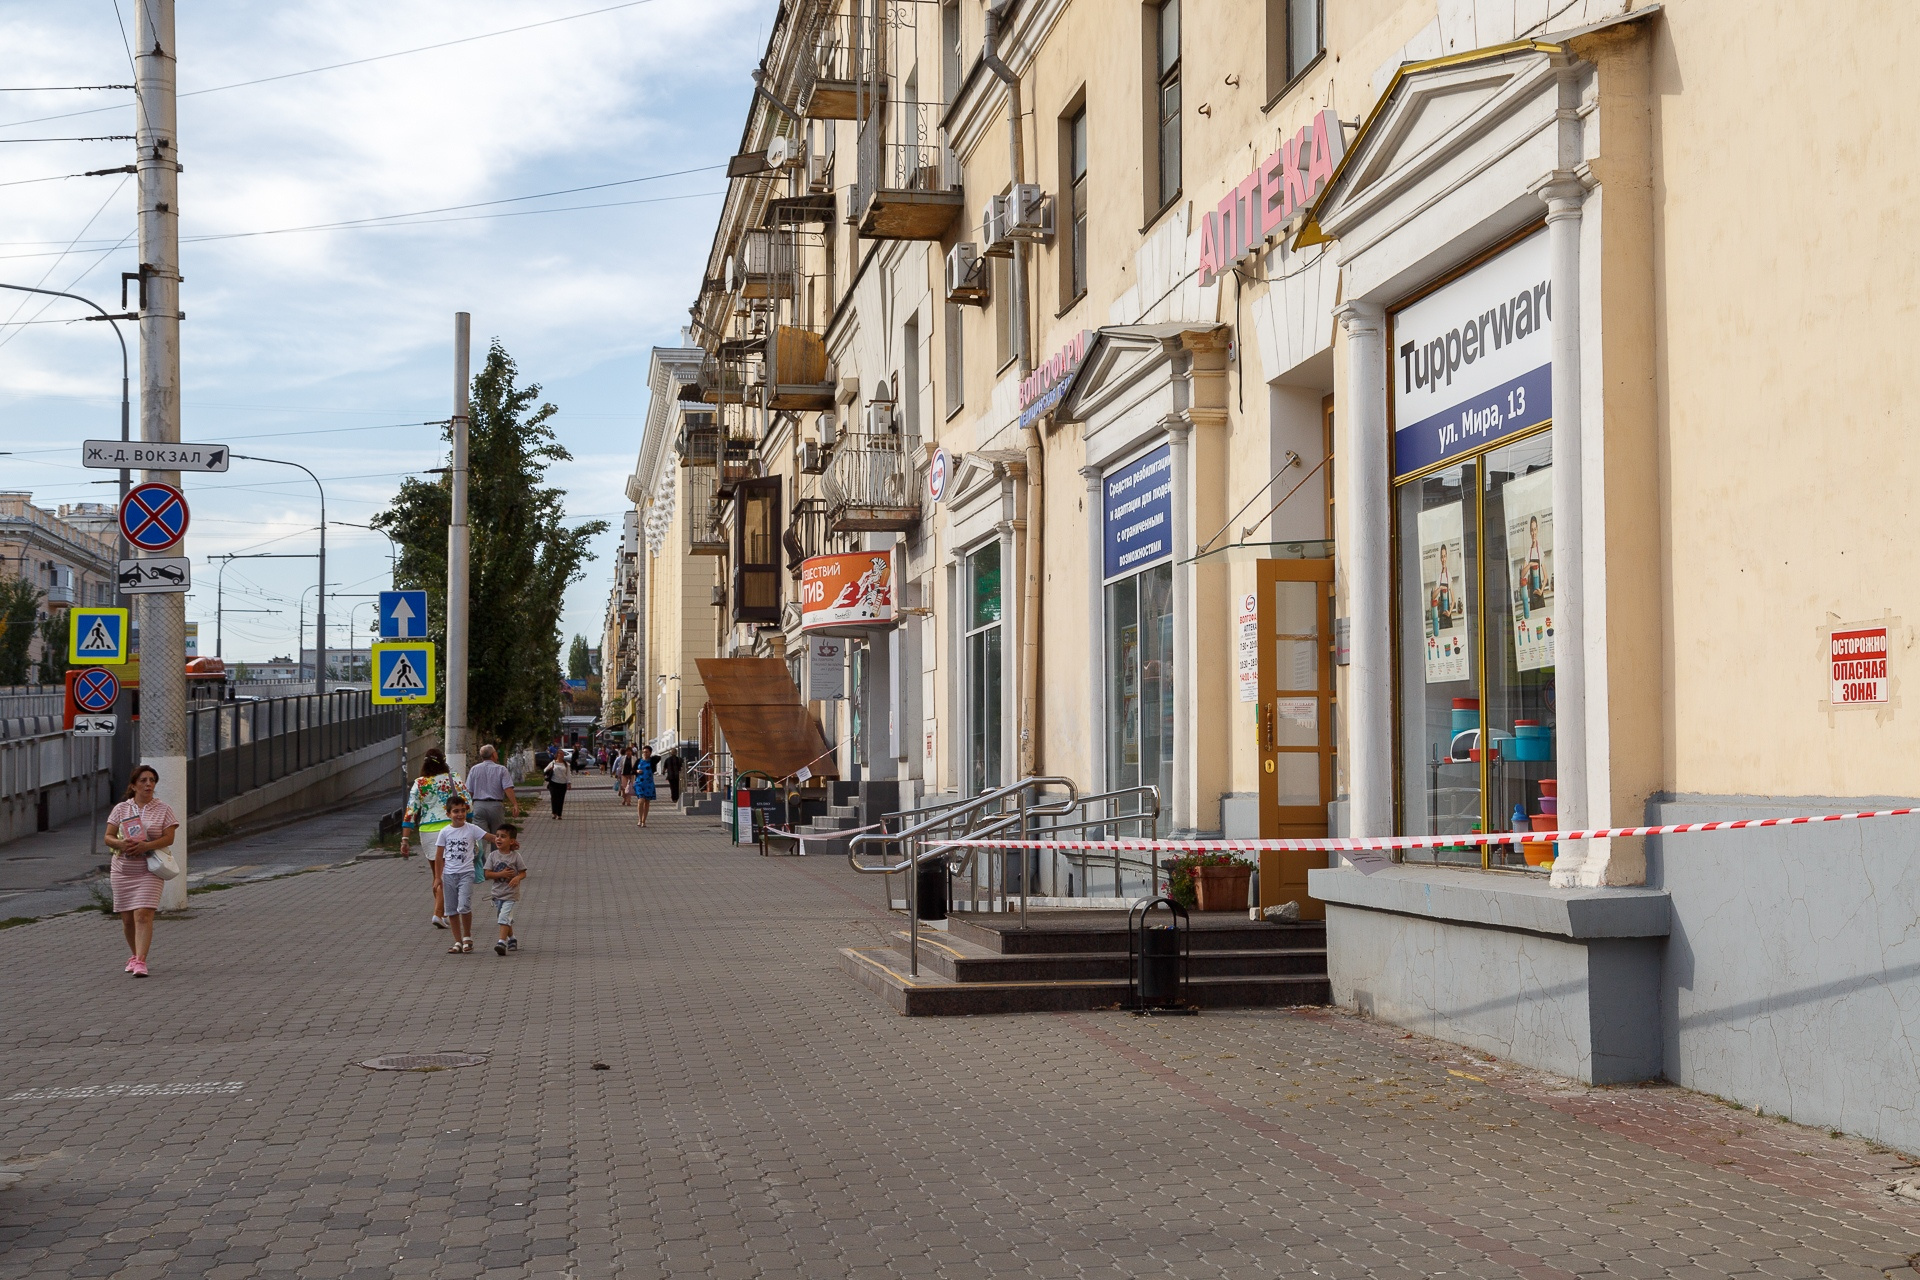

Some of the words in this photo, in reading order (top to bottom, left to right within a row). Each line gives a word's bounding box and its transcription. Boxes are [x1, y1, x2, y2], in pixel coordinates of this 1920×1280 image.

[1198, 109, 1336, 287] АПТЕКА
[1018, 329, 1086, 411] ВОЛГОФАРМ
[1438, 424, 1459, 454] ул.
[1461, 403, 1504, 438] Мира,
[1507, 385, 1526, 420] 13
[87, 448, 129, 463] Ж.-Д.
[134, 449, 201, 463] ВОКЗАЛ
[1109, 474, 1133, 499] Средства
[1109, 509, 1114, 522] и
[1114, 497, 1141, 521] адаптации
[1141, 489, 1152, 509] для
[1116, 531, 1121, 543] с
[1121, 511, 1164, 543] ограниченными
[1119, 539, 1162, 567] возможностями
[803, 561, 841, 581] ТЕШЕСТВИЙ
[803, 580, 825, 605] ТИВ
[1832, 635, 1886, 656] ОСТОРОЖНО
[1833, 659, 1887, 681] ОПАСНАЯ
[1842, 682, 1877, 701] ЗОНА!
